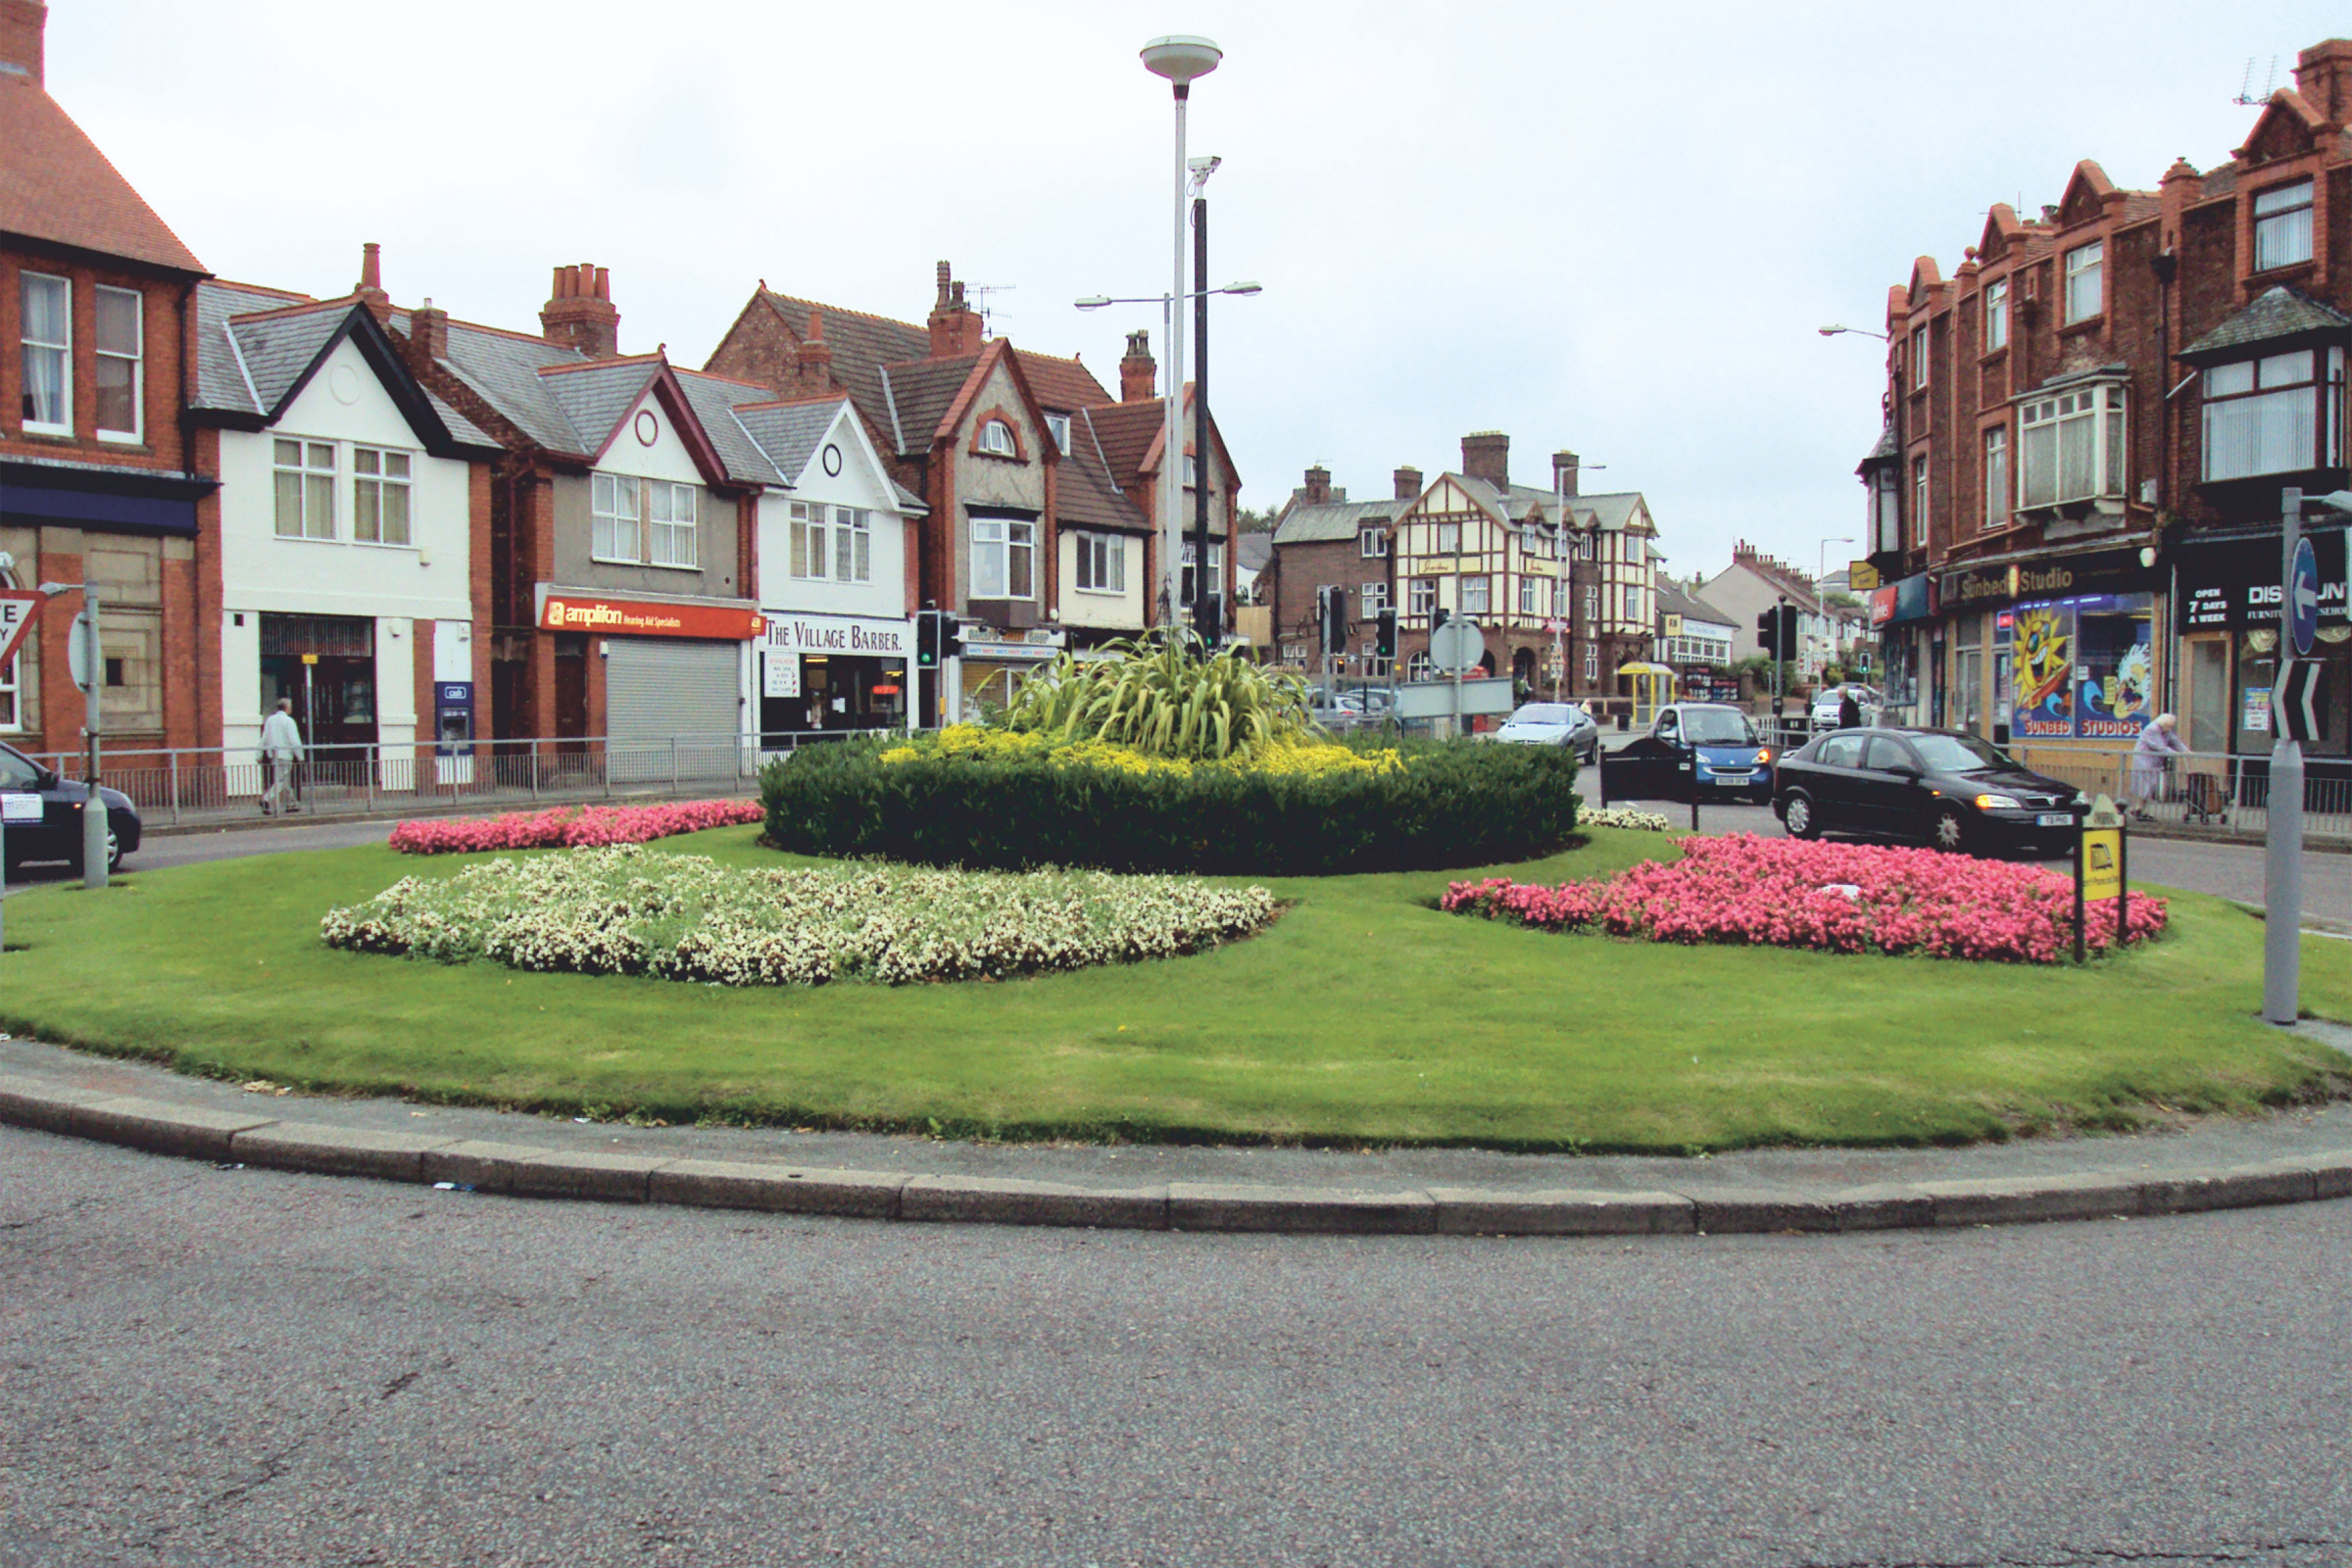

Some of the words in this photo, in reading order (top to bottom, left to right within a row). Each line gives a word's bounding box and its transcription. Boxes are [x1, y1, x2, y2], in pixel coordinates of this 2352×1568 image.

[1962, 574, 2009, 600] Sunbed
[2021, 567, 2073, 592] Studio
[2195, 588, 2221, 598] OPEN
[2188, 601, 2199, 613] 7
[2202, 600, 2228, 611] DAYS
[565, 604, 622, 627] amplifon
[624, 615, 645, 628] Hearing
[645, 615, 655, 626] Aid
[655, 615, 681, 628] Specialists
[2187, 615, 2197, 624] A
[2198, 612, 2226, 623] WEEK
[767, 620, 790, 646] THE
[795, 621, 846, 649] VILLAGE
[852, 625, 903, 651] BARBER.
[2025, 719, 2071, 735] SUNBED
[2081, 718, 2142, 736] STUDIOS
